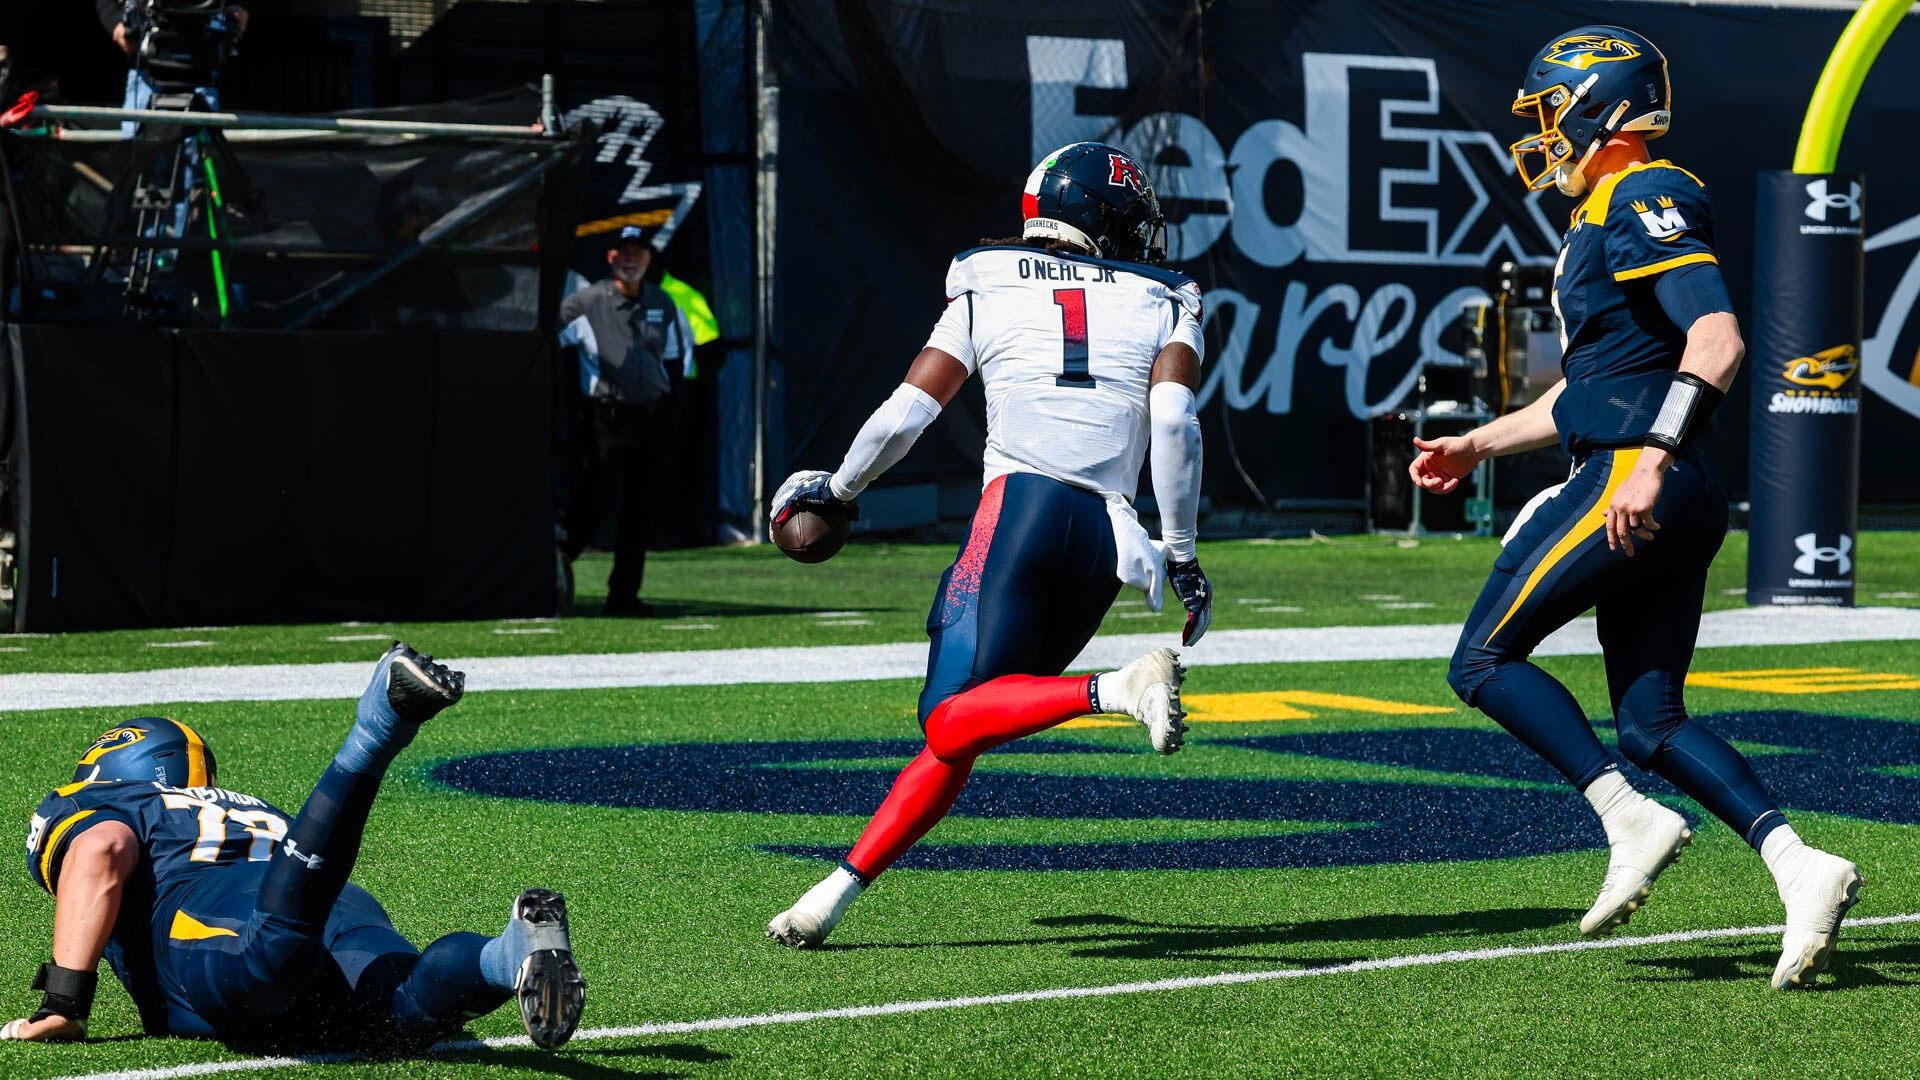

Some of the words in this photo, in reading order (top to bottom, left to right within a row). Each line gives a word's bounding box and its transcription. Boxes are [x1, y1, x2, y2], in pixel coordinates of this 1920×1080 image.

[1026, 35, 1560, 267] FedEx
[1018, 257, 1085, 281] O'NEAL
[1092, 267, 1117, 283] JR
[1053, 288, 1097, 389] 1
[1195, 280, 1494, 421] ares
